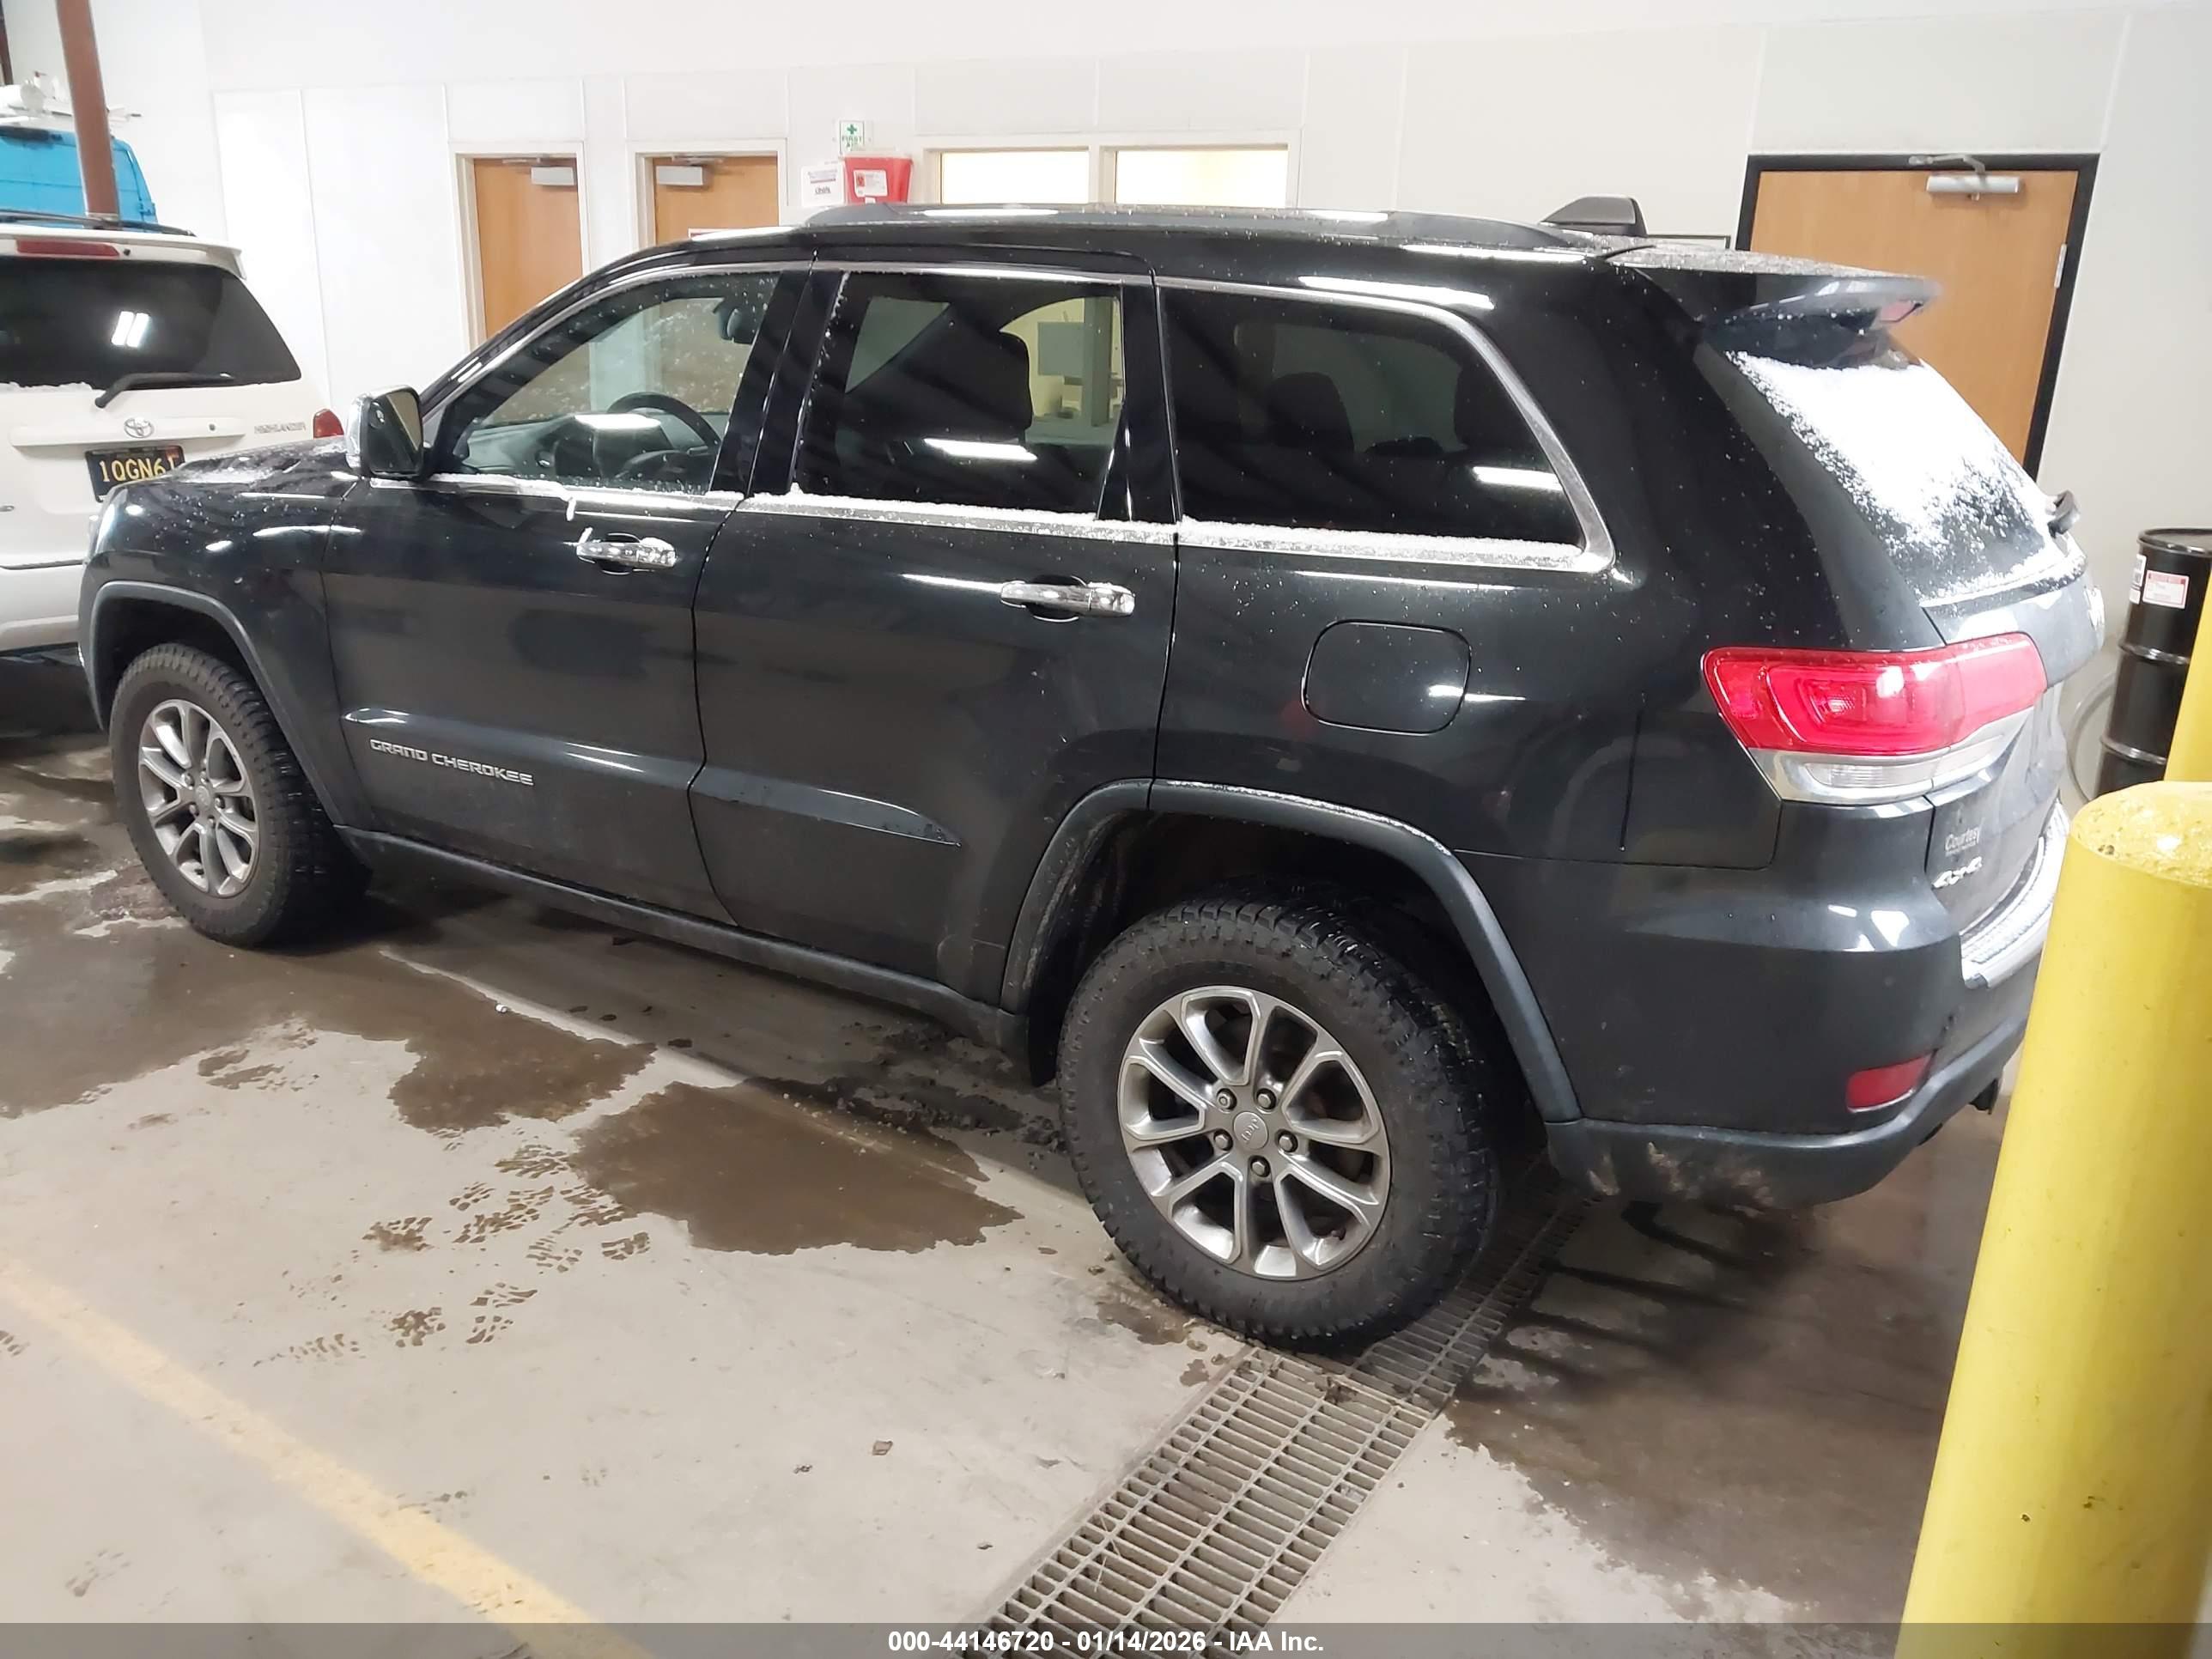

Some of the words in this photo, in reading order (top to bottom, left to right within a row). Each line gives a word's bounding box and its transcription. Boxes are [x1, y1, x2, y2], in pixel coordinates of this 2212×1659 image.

[253, 421, 307, 434] HIGHLANDER
[370, 739, 428, 761] GRAND
[431, 753, 534, 786] CHEROKEE
[1945, 825, 1979, 851] Courtesy
